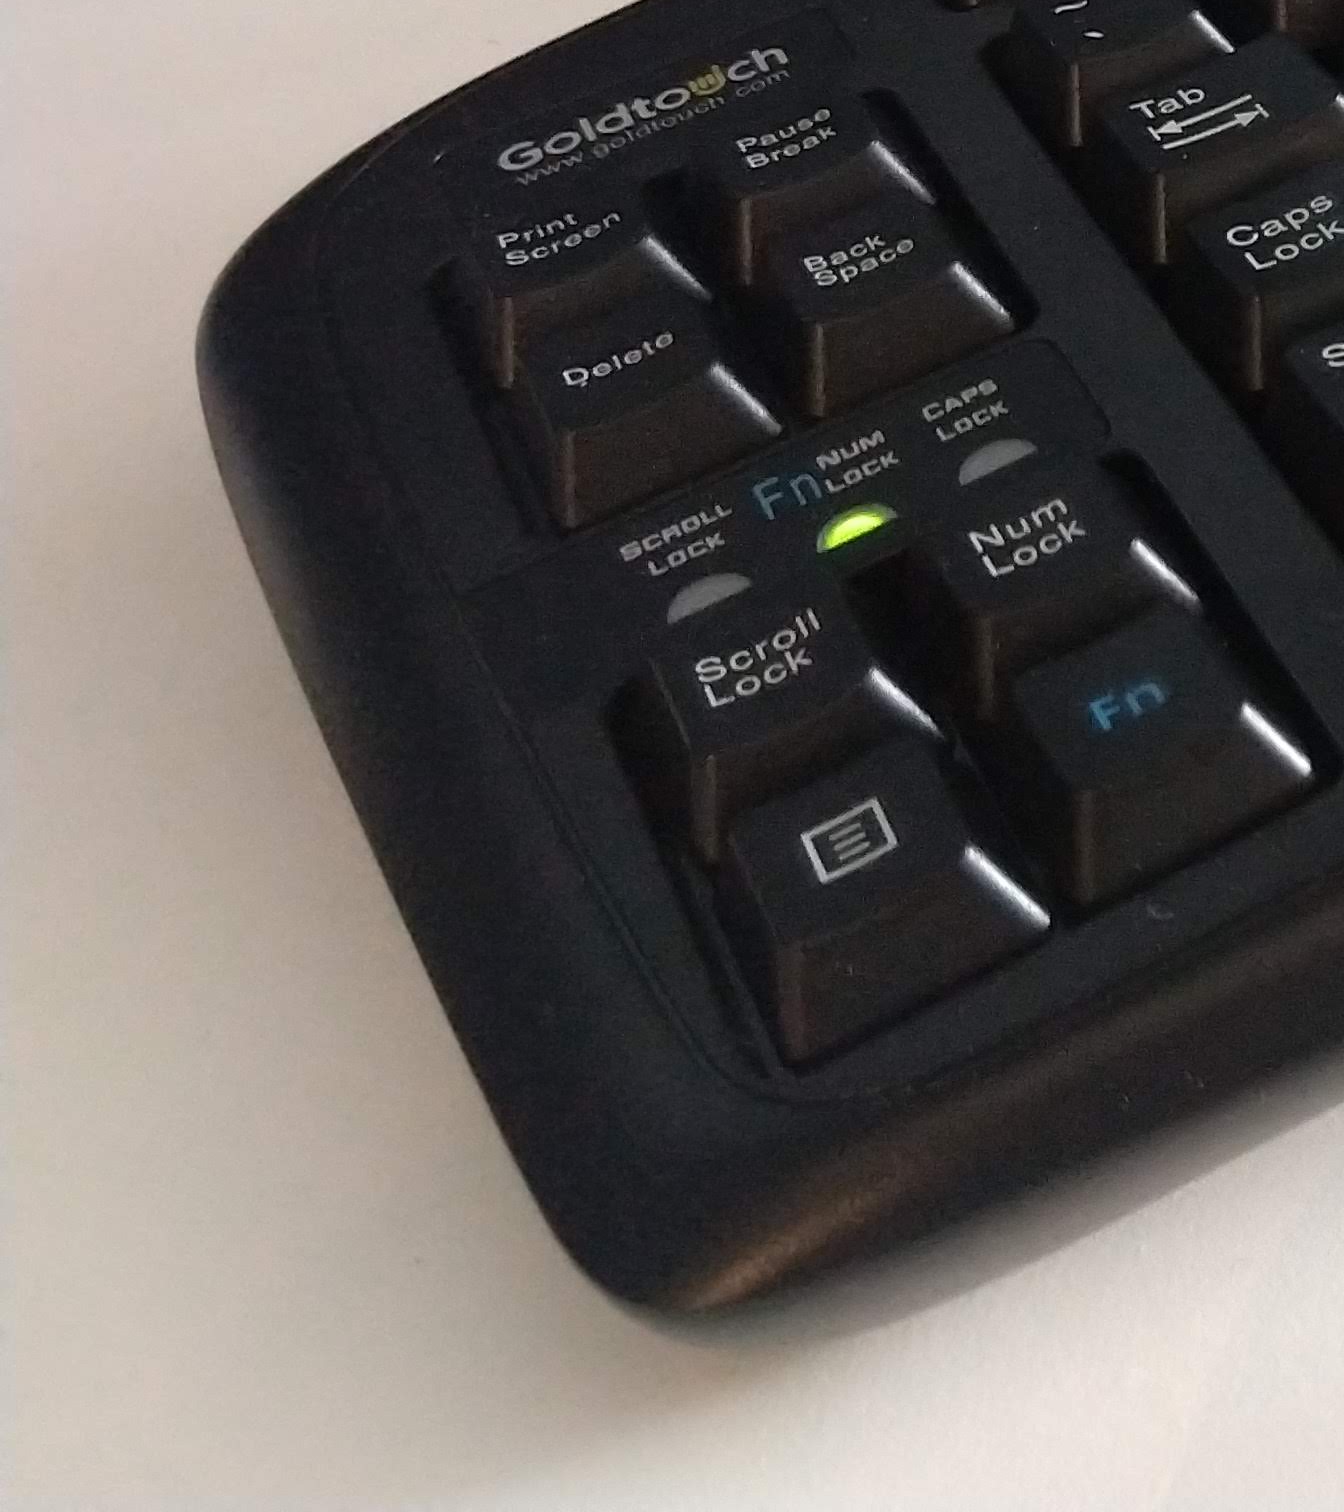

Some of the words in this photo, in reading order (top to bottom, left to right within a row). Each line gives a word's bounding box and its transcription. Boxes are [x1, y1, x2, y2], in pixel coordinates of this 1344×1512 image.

[498, 46, 789, 172] Goldtouch
[1129, 85, 1207, 120] Tab
[736, 107, 832, 155] Pause
[745, 125, 838, 169] Break
[497, 211, 579, 248] Print
[505, 210, 622, 267] Screen
[1226, 194, 1335, 249] Caps
[803, 232, 887, 273] Back
[813, 238, 915, 287] Space
[561, 331, 675, 387] Delete
[921, 379, 999, 422] CAPS
[934, 400, 1010, 442] LOCK
[816, 430, 886, 470] NUM
[824, 449, 900, 494] LOCK
[752, 471, 823, 519] Fn
[619, 502, 733, 562] SCROLL
[967, 498, 1069, 555] Num
[981, 519, 1087, 578] Lock
[647, 532, 725, 575] LOCK
[695, 607, 823, 684] Scroll
[704, 646, 814, 708] Lock
[1088, 680, 1167, 732] Fn
